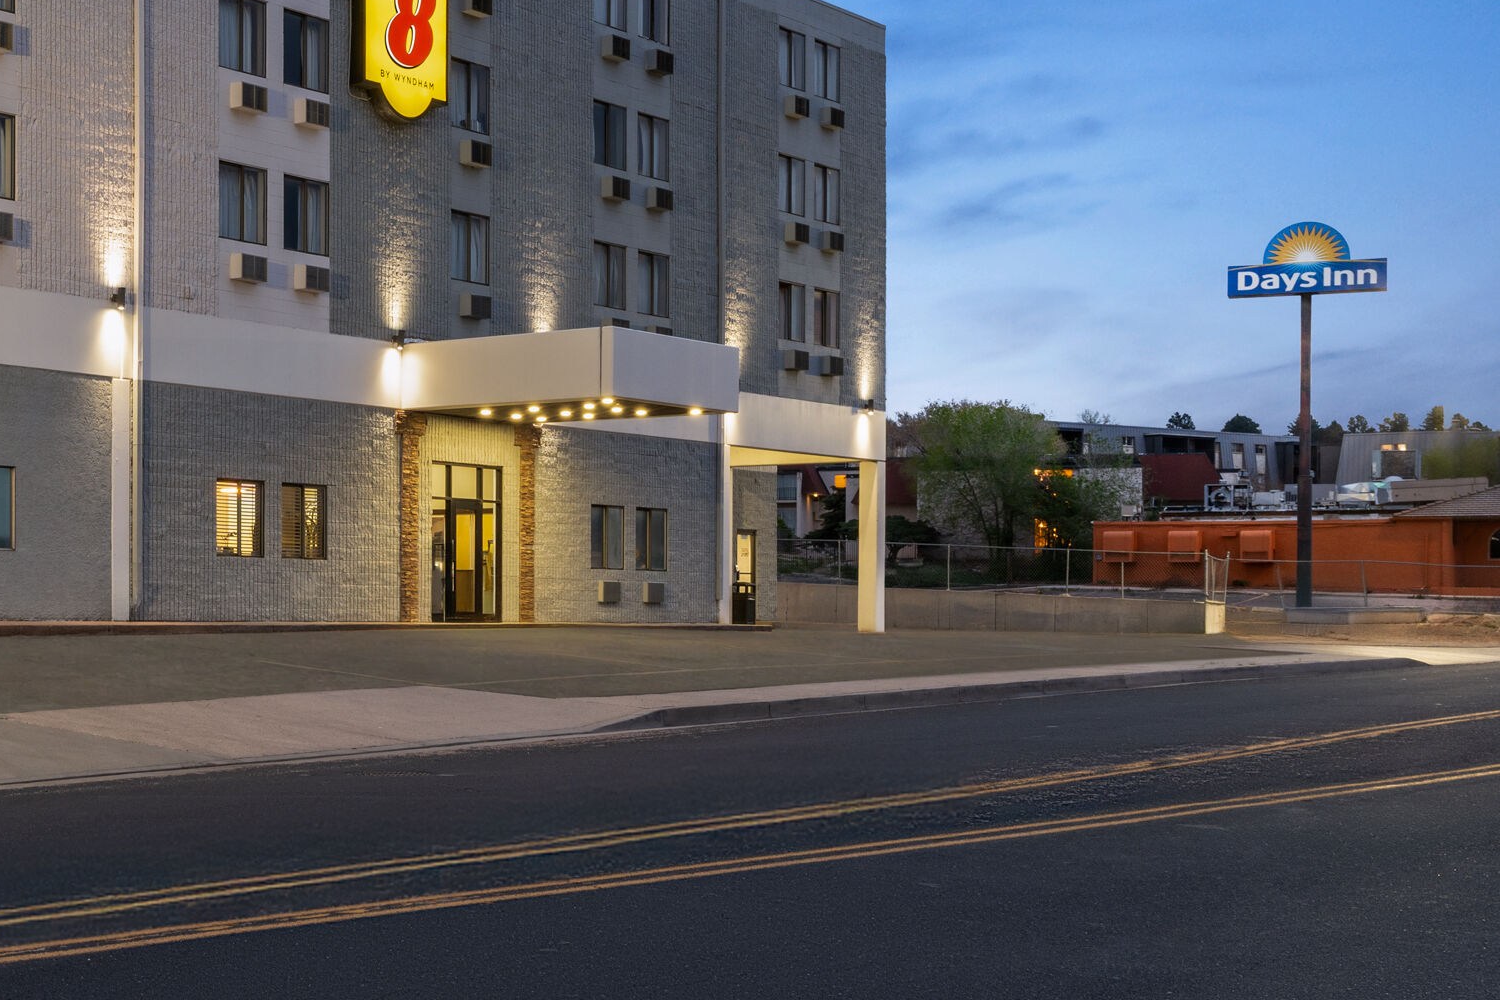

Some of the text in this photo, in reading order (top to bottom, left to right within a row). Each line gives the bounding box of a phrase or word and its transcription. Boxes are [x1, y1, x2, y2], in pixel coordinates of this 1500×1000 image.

[380, 69, 435, 91] BY WYNDHAM
[1237, 267, 1377, 291] Days Inn
